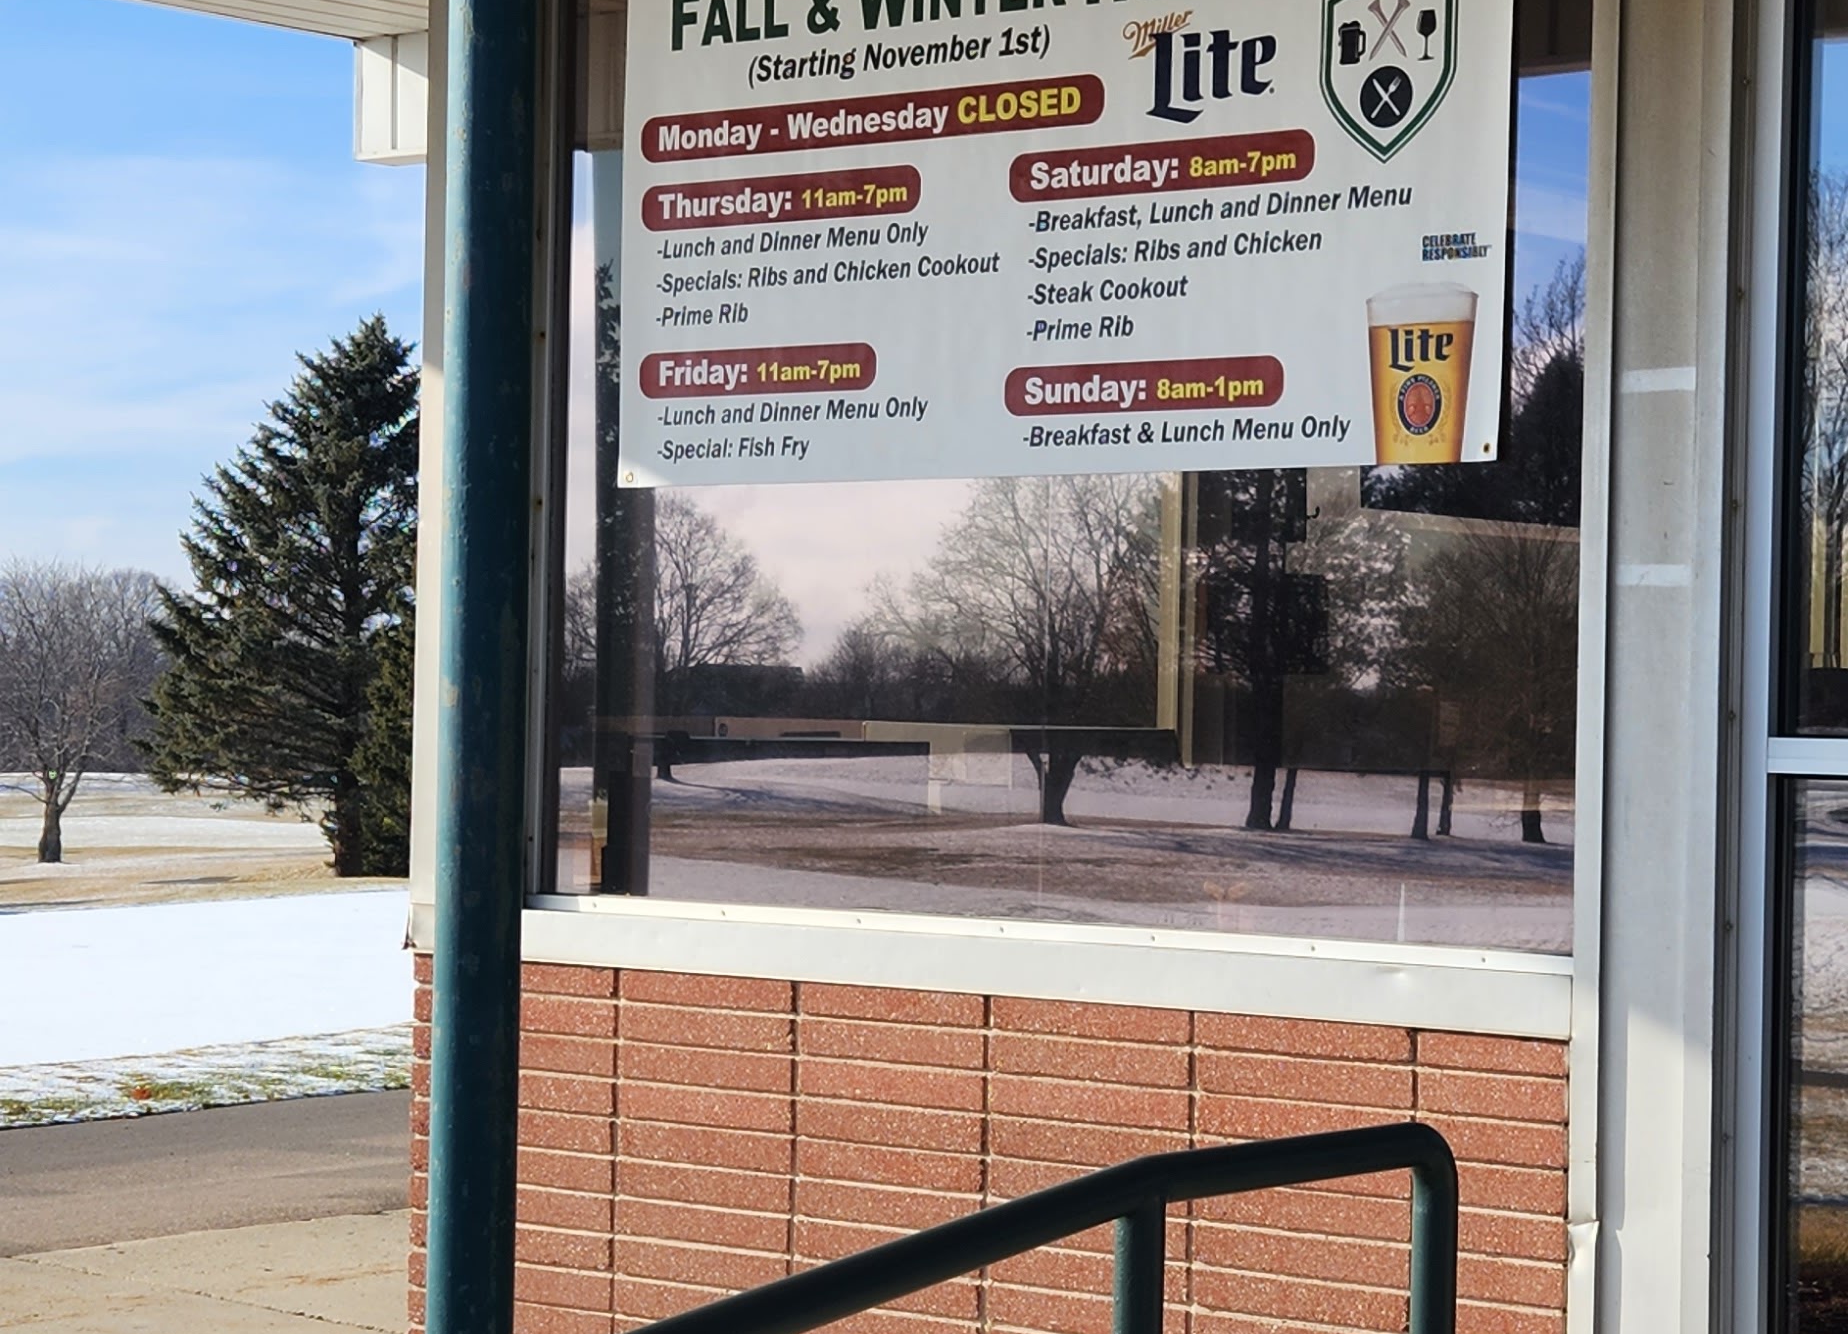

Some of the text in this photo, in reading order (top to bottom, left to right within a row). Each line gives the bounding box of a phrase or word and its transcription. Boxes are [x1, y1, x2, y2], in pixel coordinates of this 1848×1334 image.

[1123, 10, 1193, 60] Miller
[748, 24, 1050, 89] (Starting November 1st)
[1146, 30, 1277, 123] Lite
[658, 120, 763, 152] Monday
[787, 102, 949, 140] Wednesday
[957, 86, 1081, 124] CLOSED
[1030, 151, 1297, 190] Saturday: 8am-7pm
[658, 184, 908, 219] Thursday: 11am-7pm
[1028, 185, 1412, 233] -Breakfast, Lunch and Dinner Menu
[656, 221, 930, 260] -Lunch and Dinner Menu Only
[1028, 230, 1323, 273] -Specials: Ribs and Chicken
[1422, 232, 1476, 247] CELEBRATE
[656, 251, 1000, 297] -Specials: Ribs and Chicken Cookout
[1027, 275, 1189, 306] -Steak Cookout
[656, 303, 749, 327] -Prime Rib
[1026, 315, 1134, 341] -Prime Rib
[1388, 328, 1454, 372] Lite
[658, 358, 861, 391] Friday: 11am-7pm
[1024, 375, 1264, 408] Sunday: 8am-1pm
[657, 396, 929, 426] -Lunch and Dinner Menu Only
[656, 435, 811, 464] -Special: Fish Fry
[1023, 414, 1351, 448] -Breakfast & Lunch Menu Only
